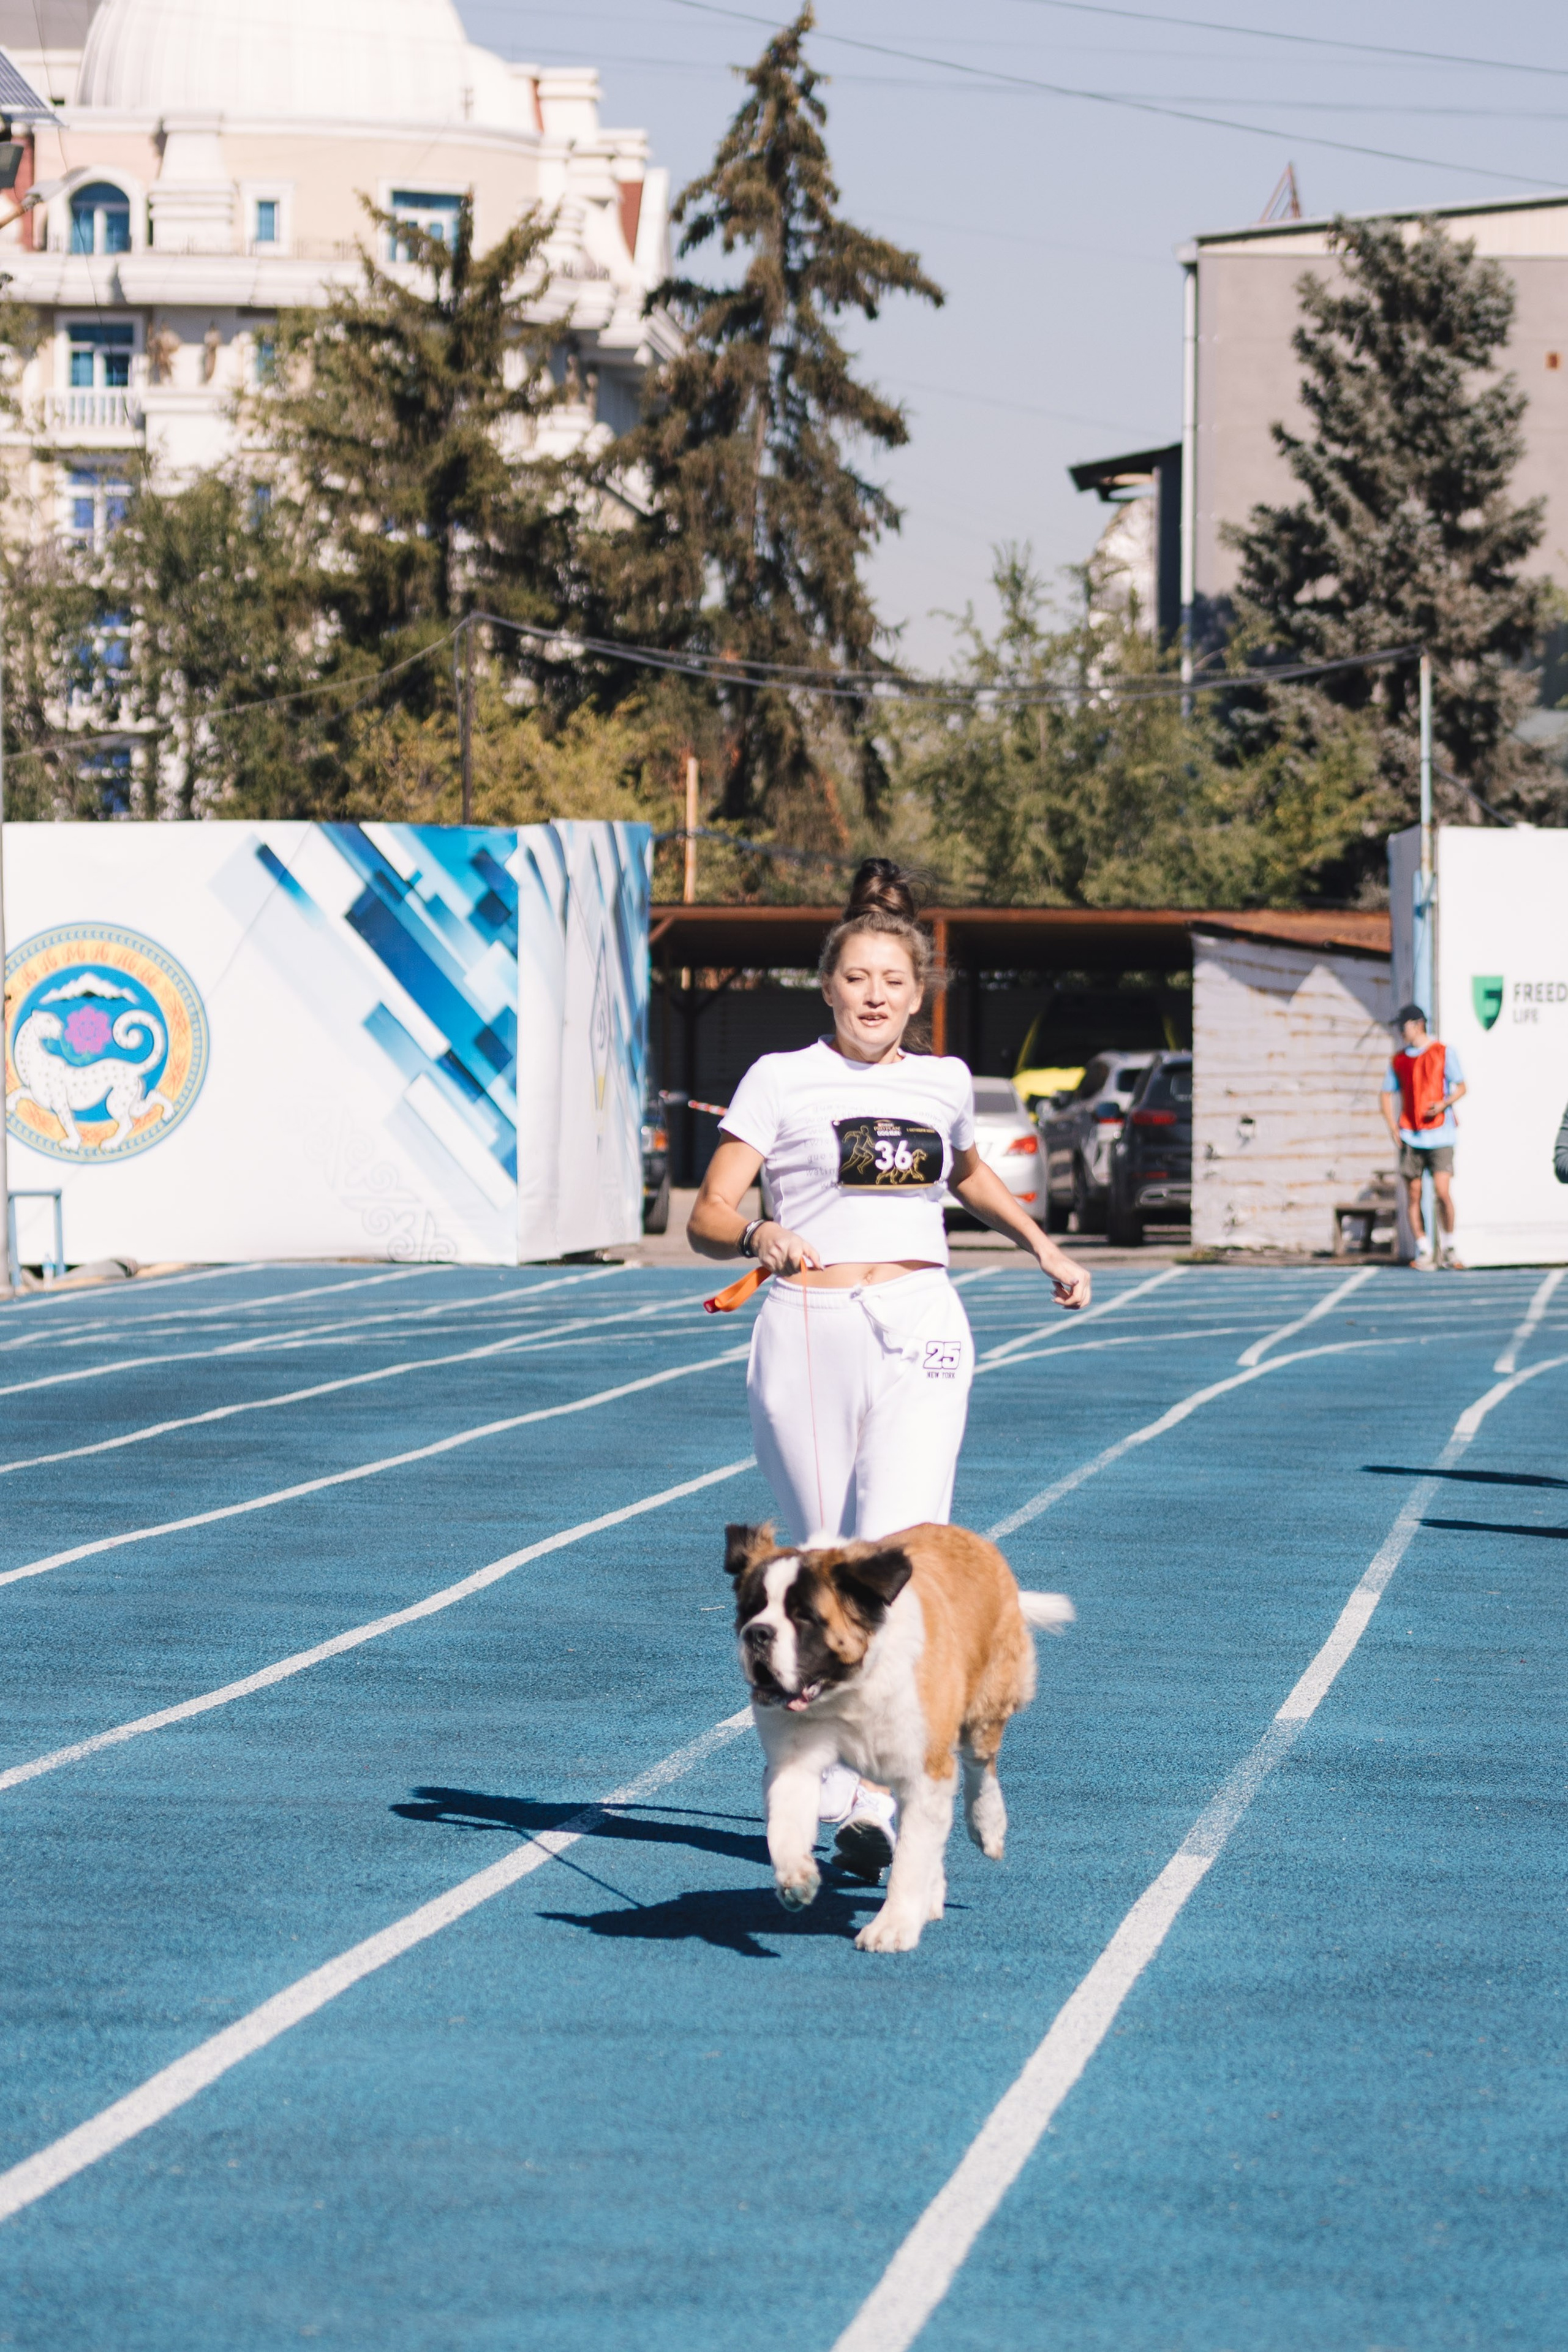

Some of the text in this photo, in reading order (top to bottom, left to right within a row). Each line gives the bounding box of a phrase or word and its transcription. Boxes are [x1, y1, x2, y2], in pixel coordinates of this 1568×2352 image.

[1513, 982, 1568, 1002] FREED
[1513, 1009, 1538, 1023] LIFE
[875, 1140, 913, 1170] 36
[922, 1340, 961, 1370] 25
